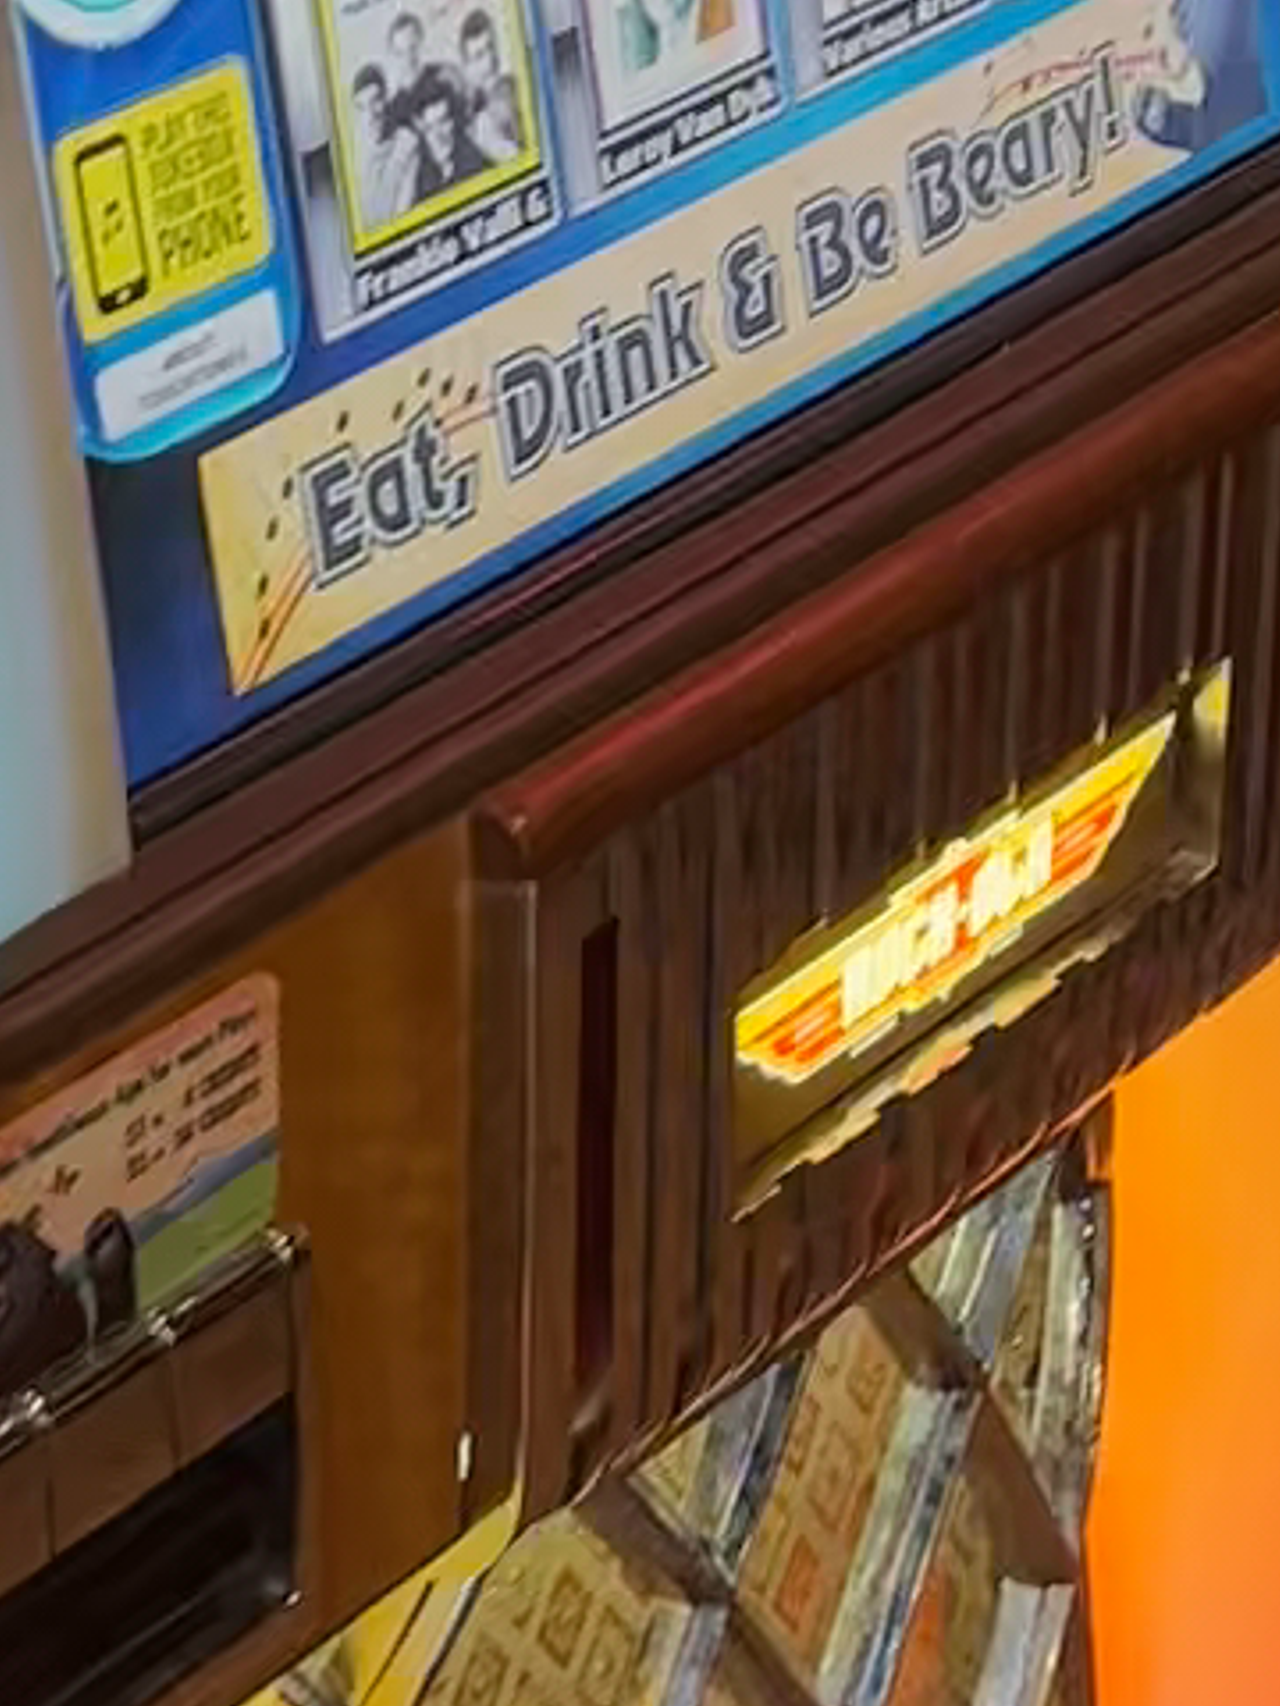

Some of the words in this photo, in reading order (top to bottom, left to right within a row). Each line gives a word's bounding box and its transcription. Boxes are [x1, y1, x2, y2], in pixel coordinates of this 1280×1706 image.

[823, 14, 912, 67] Various
[600, 133, 673, 186] Leroy
[673, 105, 720, 148] Van
[158, 192, 251, 277] PHONE
[355, 234, 465, 310] Frankie
[464, 198, 526, 263] Valli
[304, 408, 477, 589] Eat,
[494, 276, 713, 479] Drink
[720, 226, 784, 353] &
[798, 187, 898, 316] Be
[910, 52, 1129, 254] Beary!
